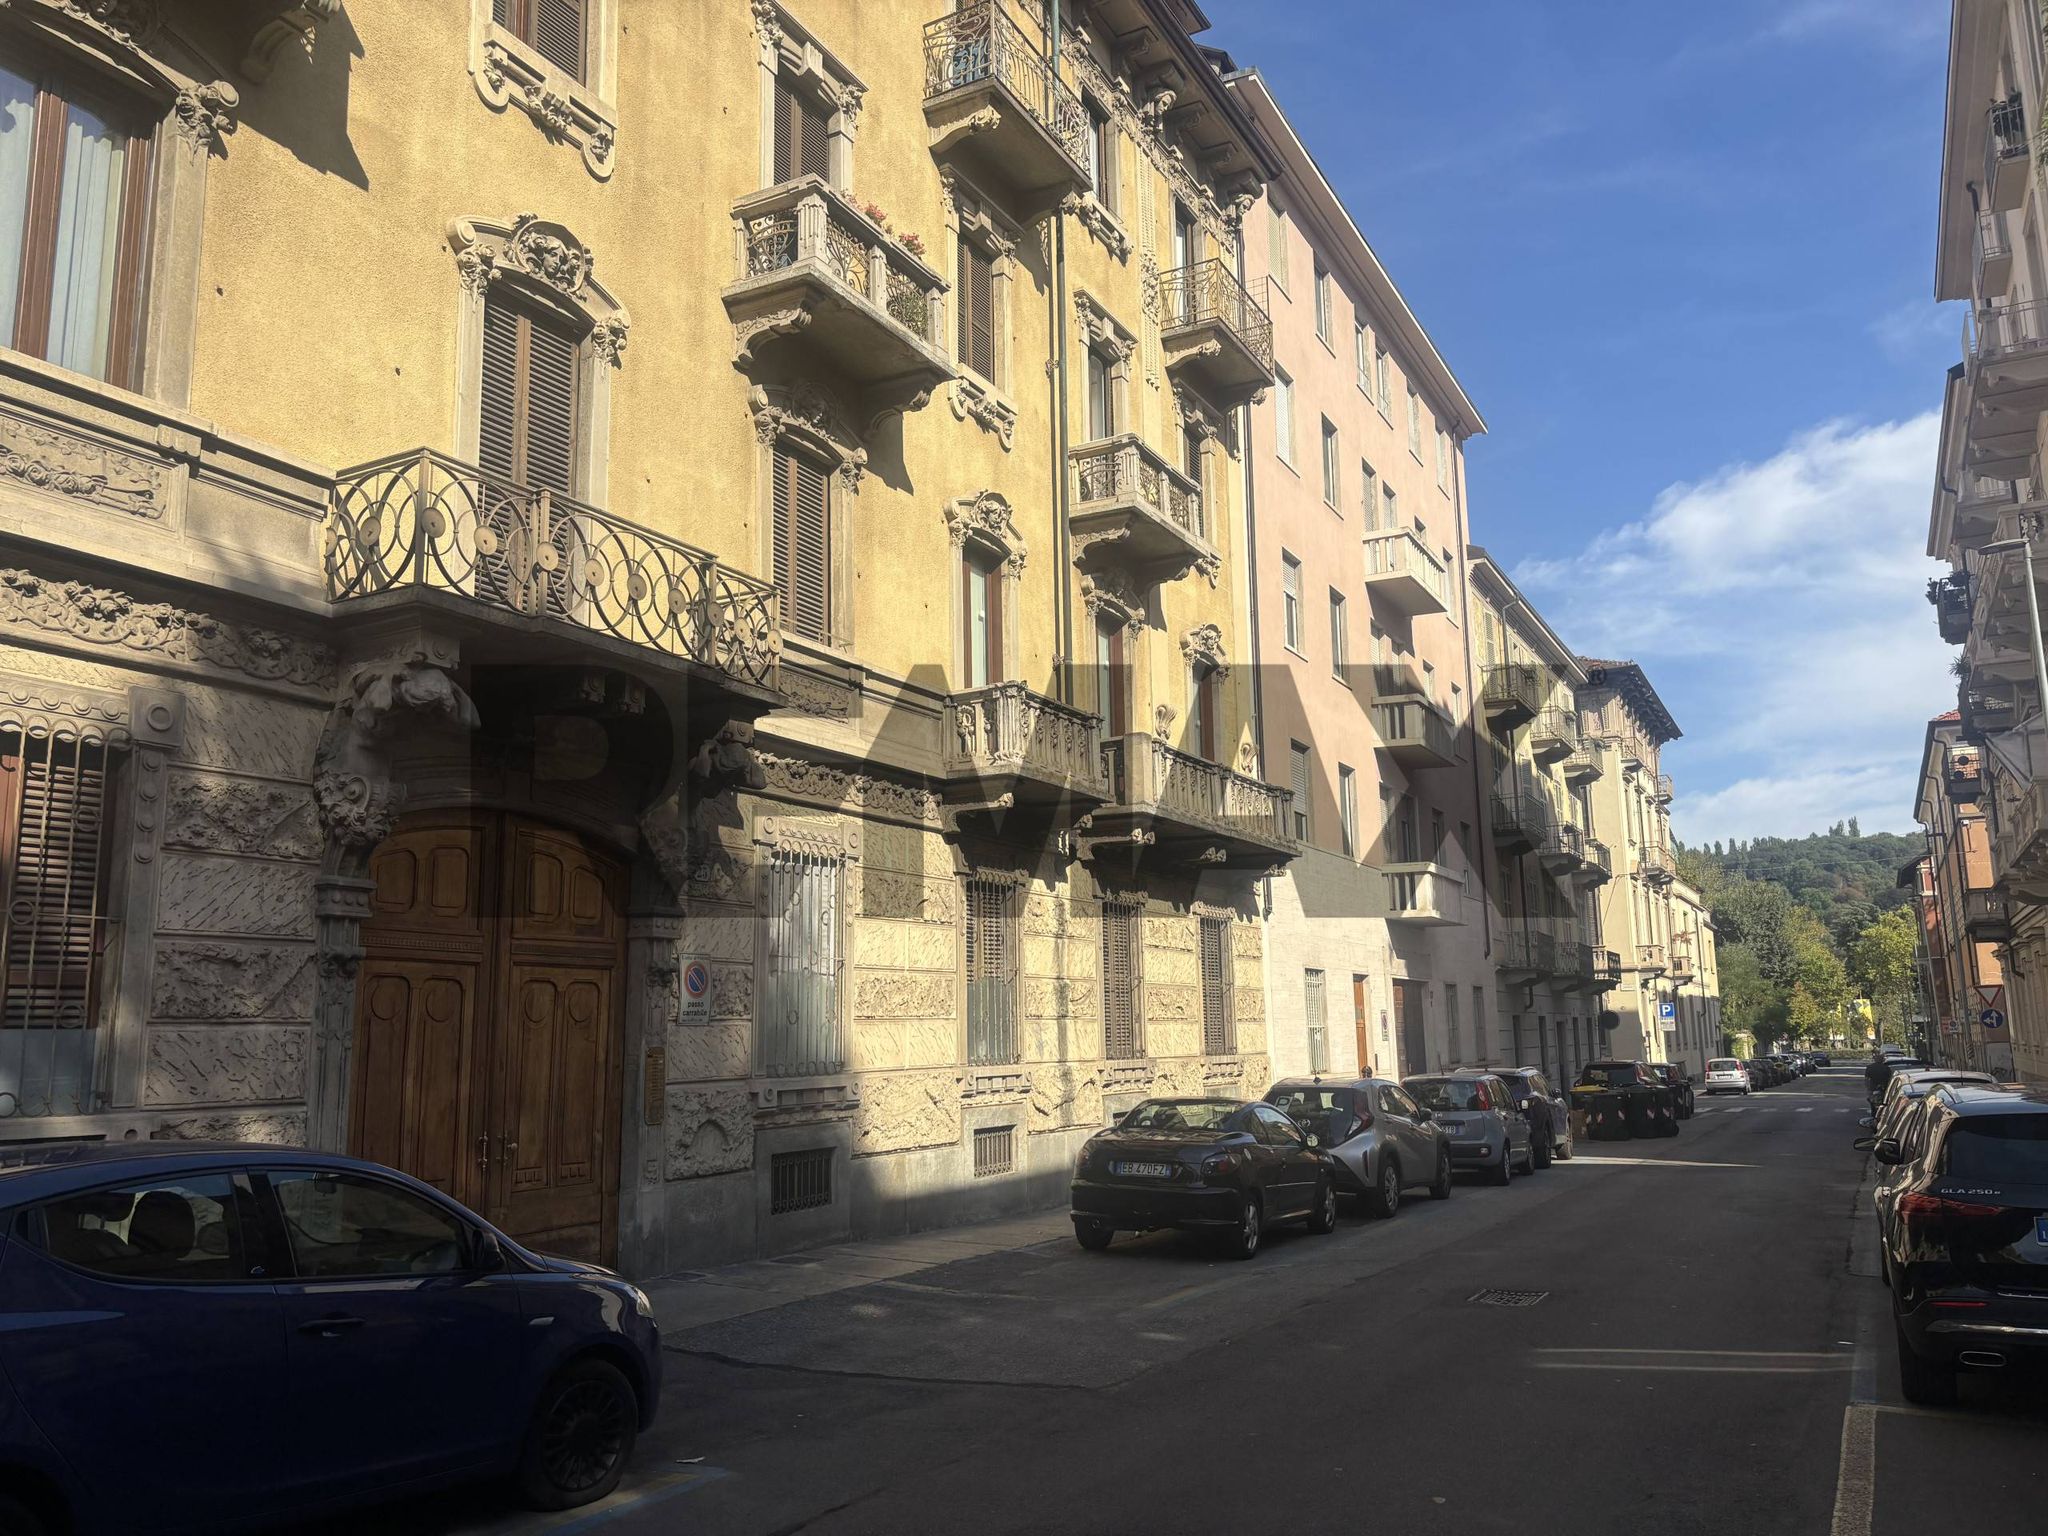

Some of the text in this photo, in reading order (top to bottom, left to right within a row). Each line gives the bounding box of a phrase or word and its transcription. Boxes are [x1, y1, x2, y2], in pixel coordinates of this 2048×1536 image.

[682, 1009, 708, 1017] carrabile
[1661, 1004, 1672, 1016] P
[1940, 1187, 1966, 1195] GLA
